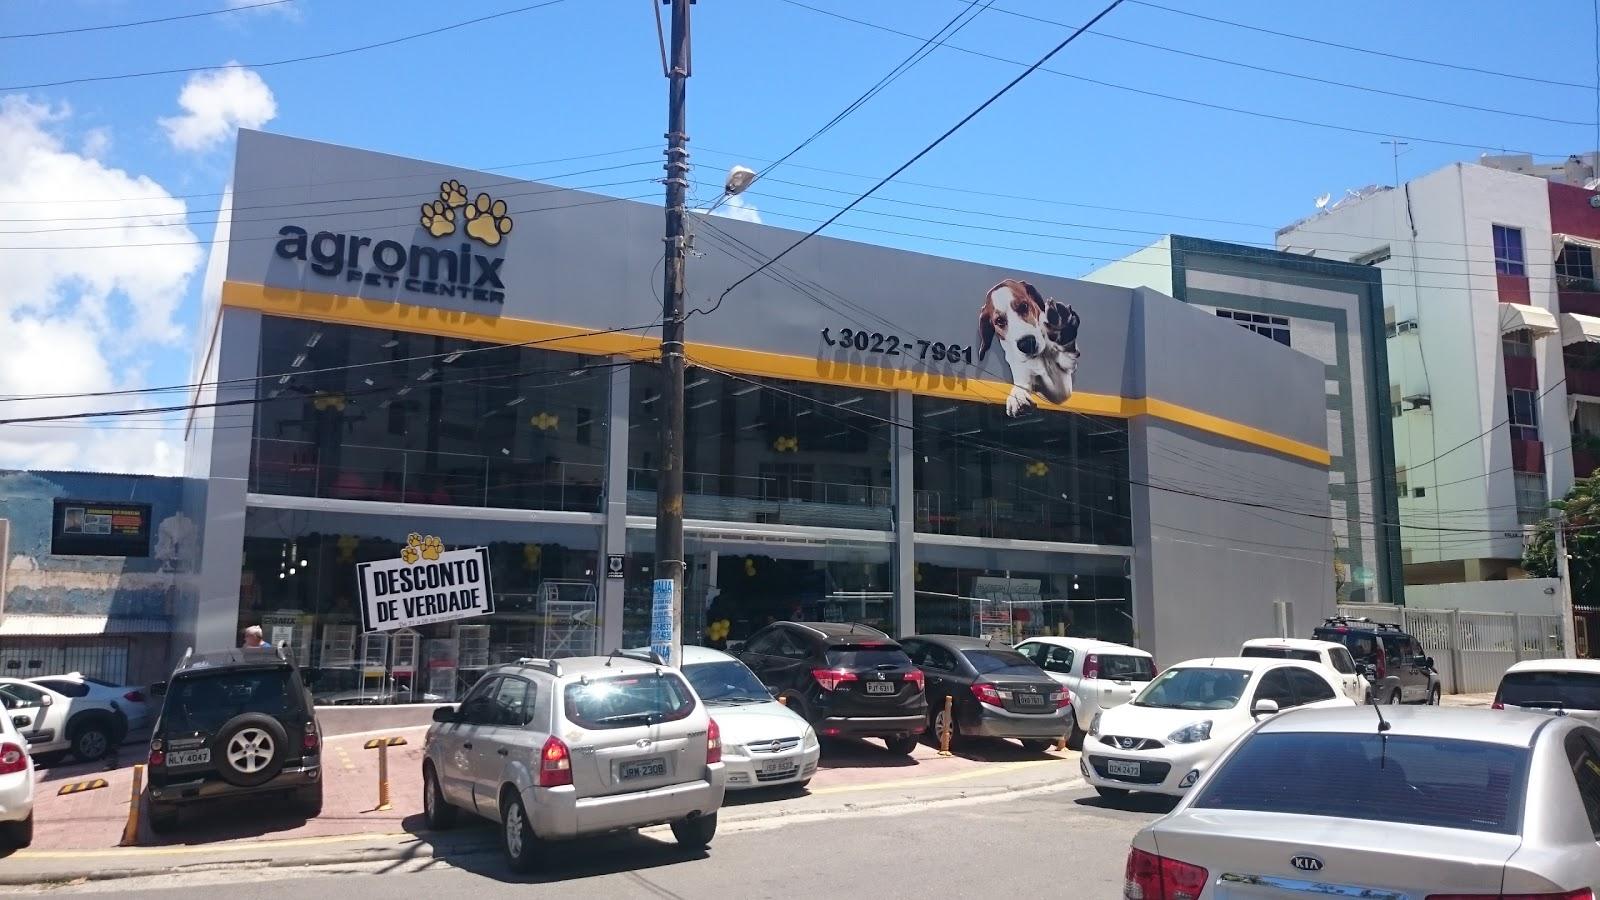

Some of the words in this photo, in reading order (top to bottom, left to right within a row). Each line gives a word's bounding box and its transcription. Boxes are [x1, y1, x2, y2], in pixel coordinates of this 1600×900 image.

[275, 225, 505, 289] agromix
[347, 270, 399, 289] PET
[405, 278, 505, 304] CENTER
[839, 328, 972, 365] 3022-7961
[373, 558, 480, 597] DESCONTO
[376, 600, 399, 623] DE
[403, 587, 481, 619] VERDADE
[1295, 857, 1319, 870] KIA
